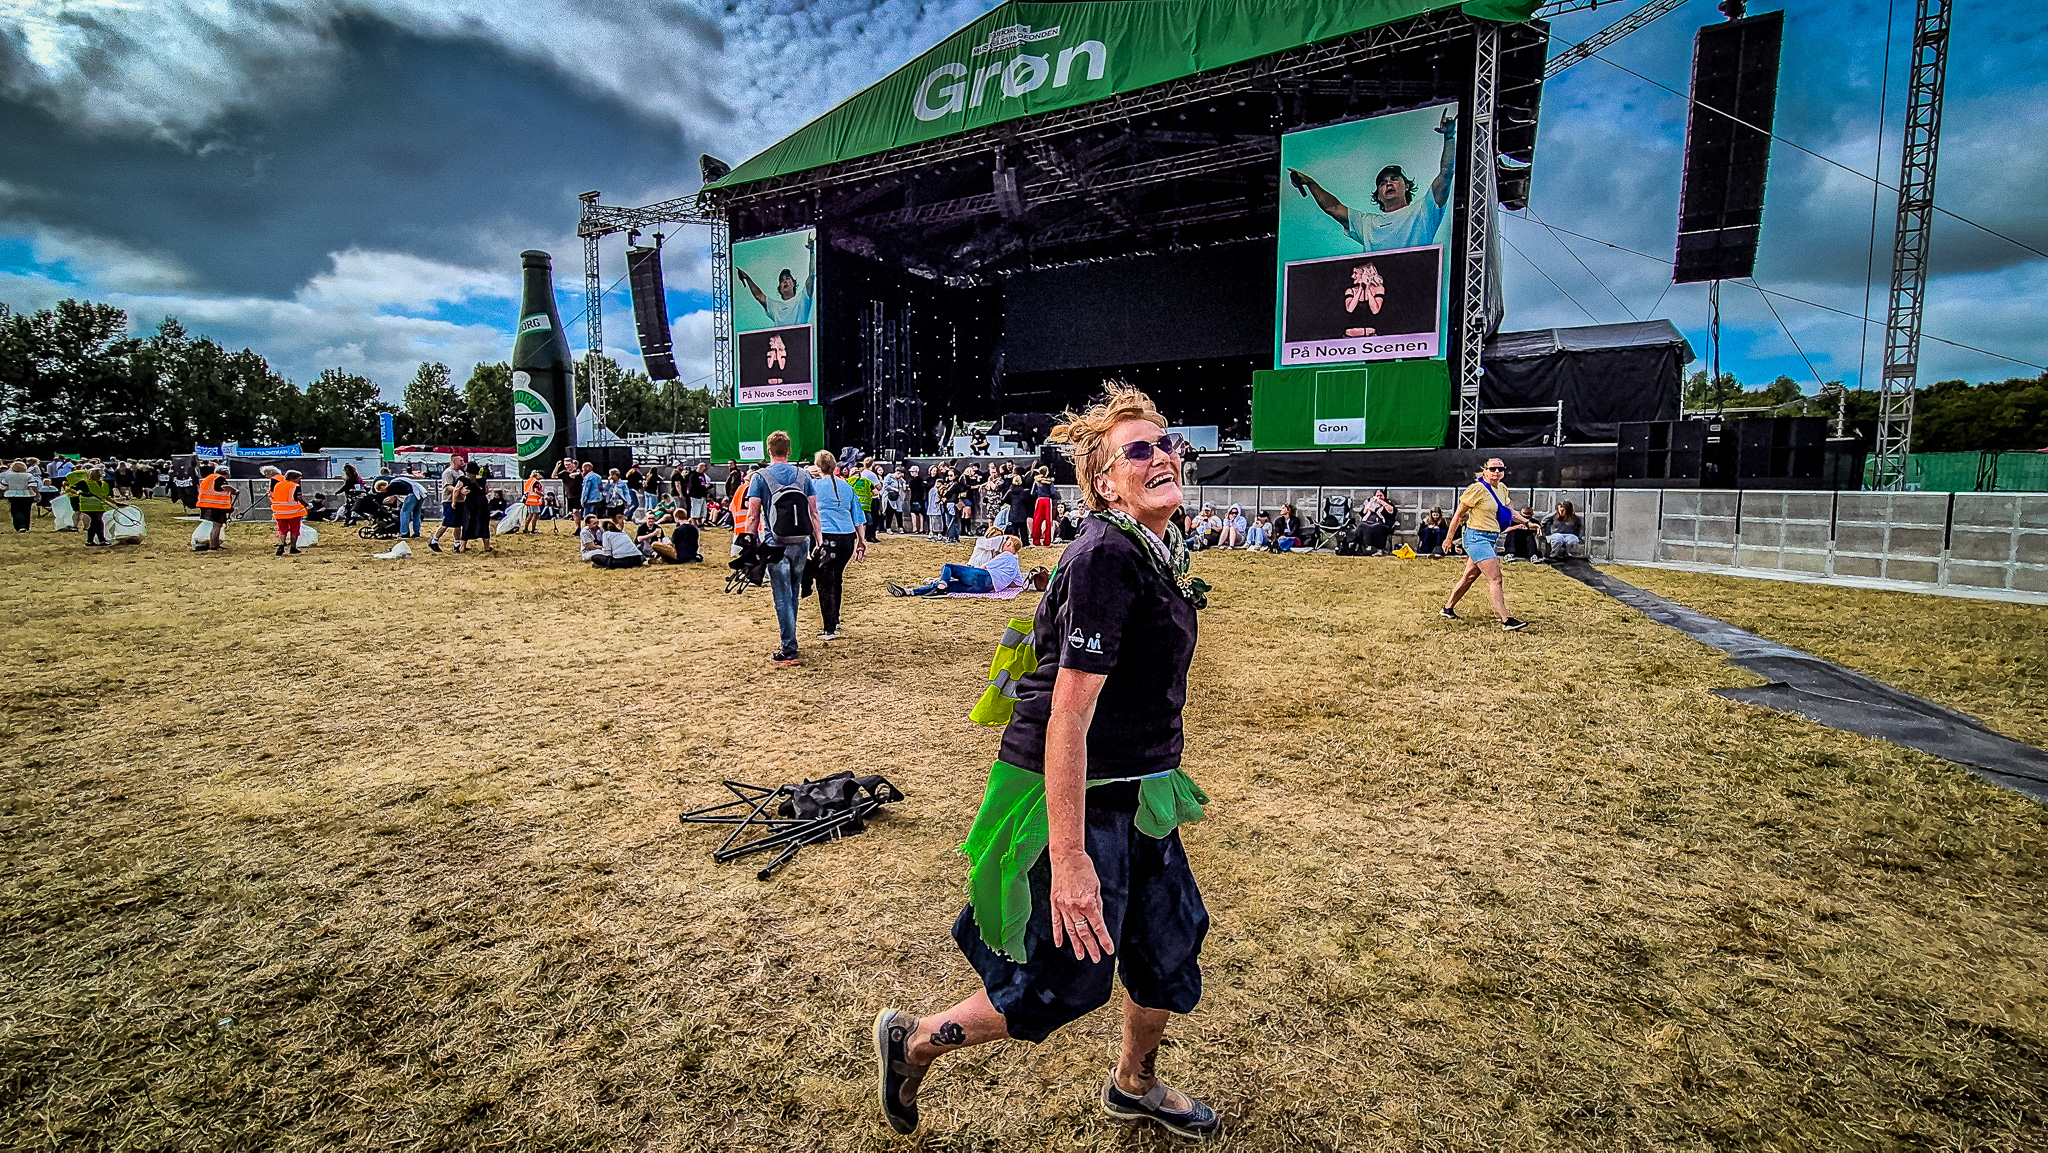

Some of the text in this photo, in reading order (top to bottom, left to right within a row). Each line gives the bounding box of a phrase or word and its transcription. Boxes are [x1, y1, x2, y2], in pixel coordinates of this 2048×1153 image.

[913, 40, 1107, 122] Grøn
[1290, 341, 1428, 359] På Nova Scenen
[742, 388, 809, 400] På Nova Scenen
[1318, 423, 1349, 433] Grøn
